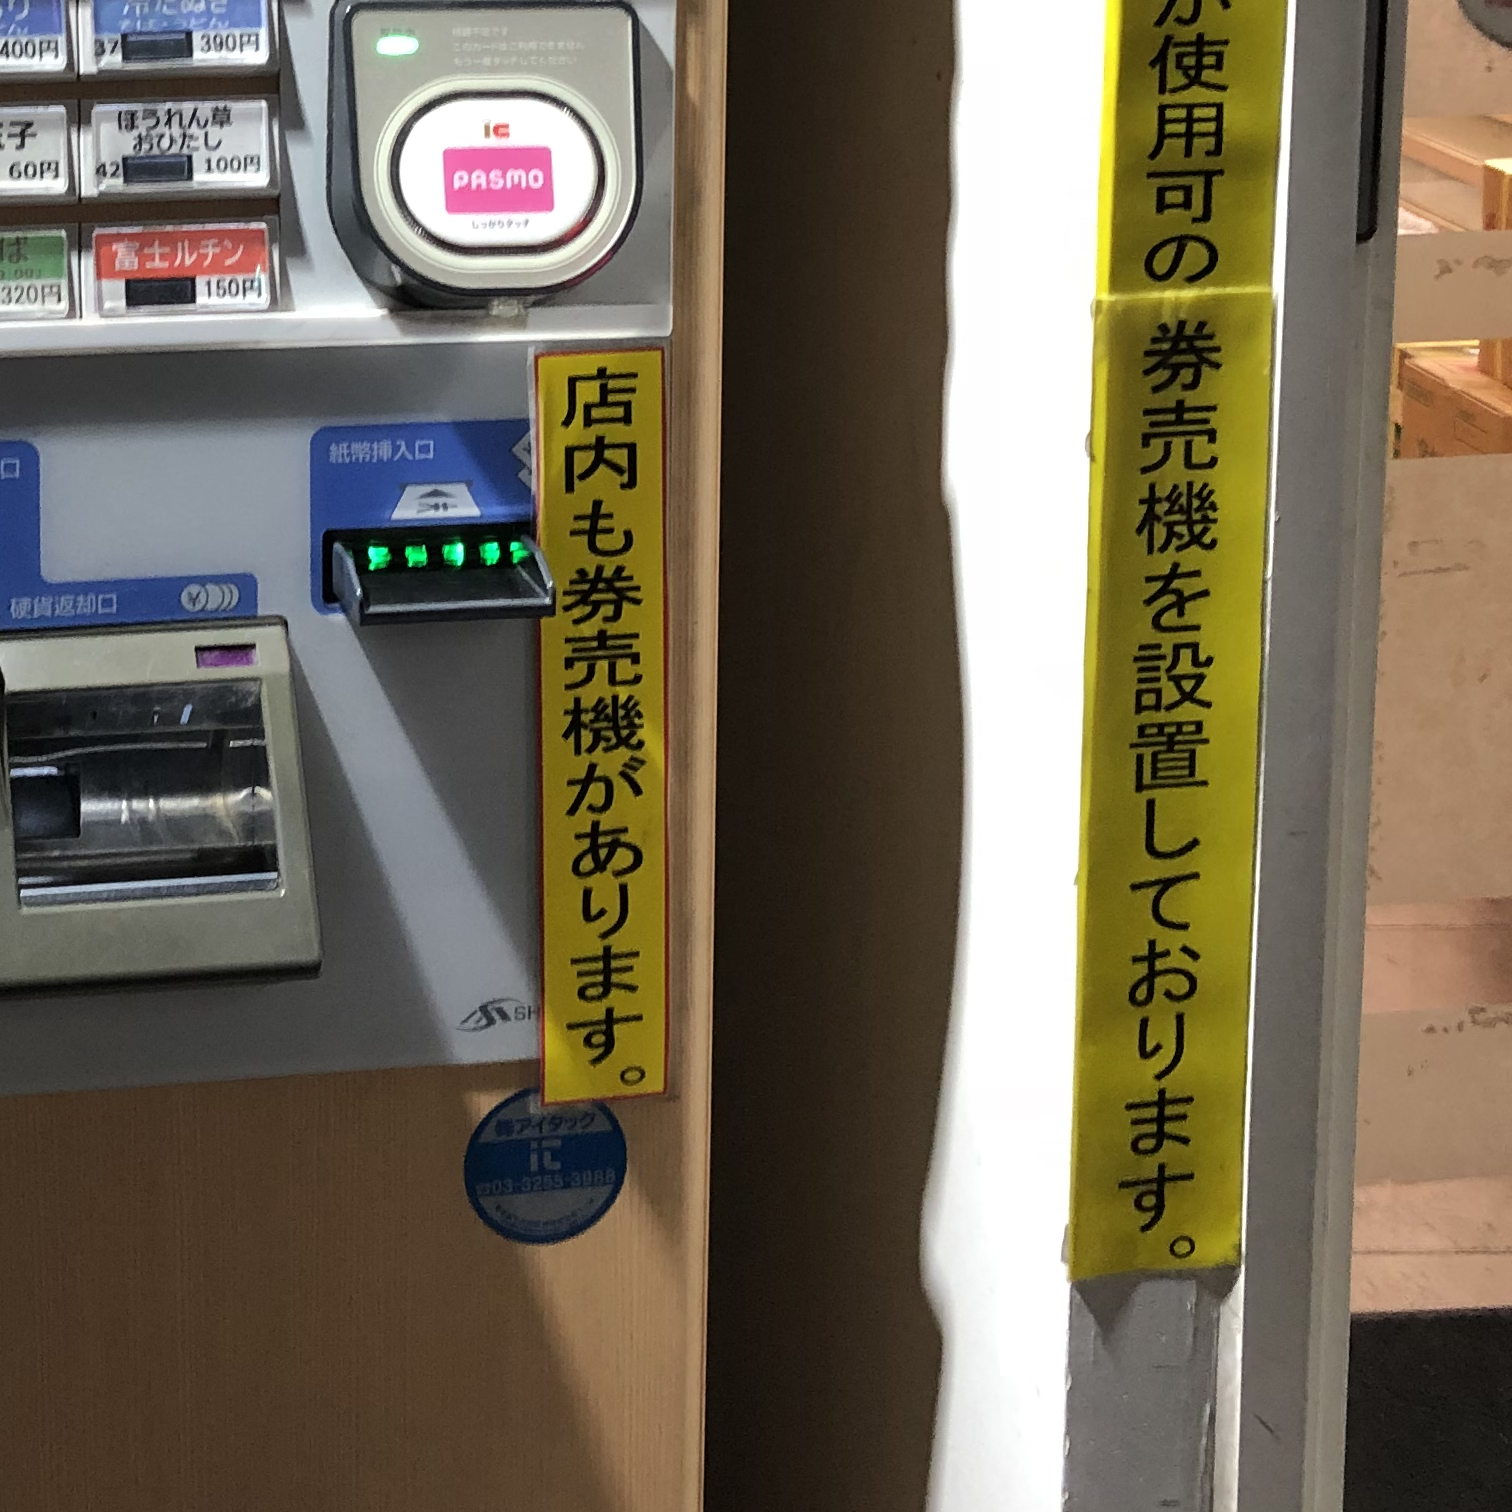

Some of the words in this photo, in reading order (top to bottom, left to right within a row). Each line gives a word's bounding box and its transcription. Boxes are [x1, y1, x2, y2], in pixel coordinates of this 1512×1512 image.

[0, 39, 59, 60] 400円
[200, 33, 260, 53] 390円
[118, 107, 232, 131] ほうれん草
[132, 131, 222, 152] おひたし
[9, 161, 59, 181] 60円
[204, 155, 261, 174] 100円
[453, 168, 544, 191] PASMO
[112, 239, 245, 272] 富士ルチン
[2, 286, 61, 305] 320円
[204, 279, 263, 299] 150円
[329, 440, 434, 464] 紙幣挿入口
[10, 593, 117, 619] 硬貨返却口
[560, 366, 645, 1087] 店内も券売機があります。
